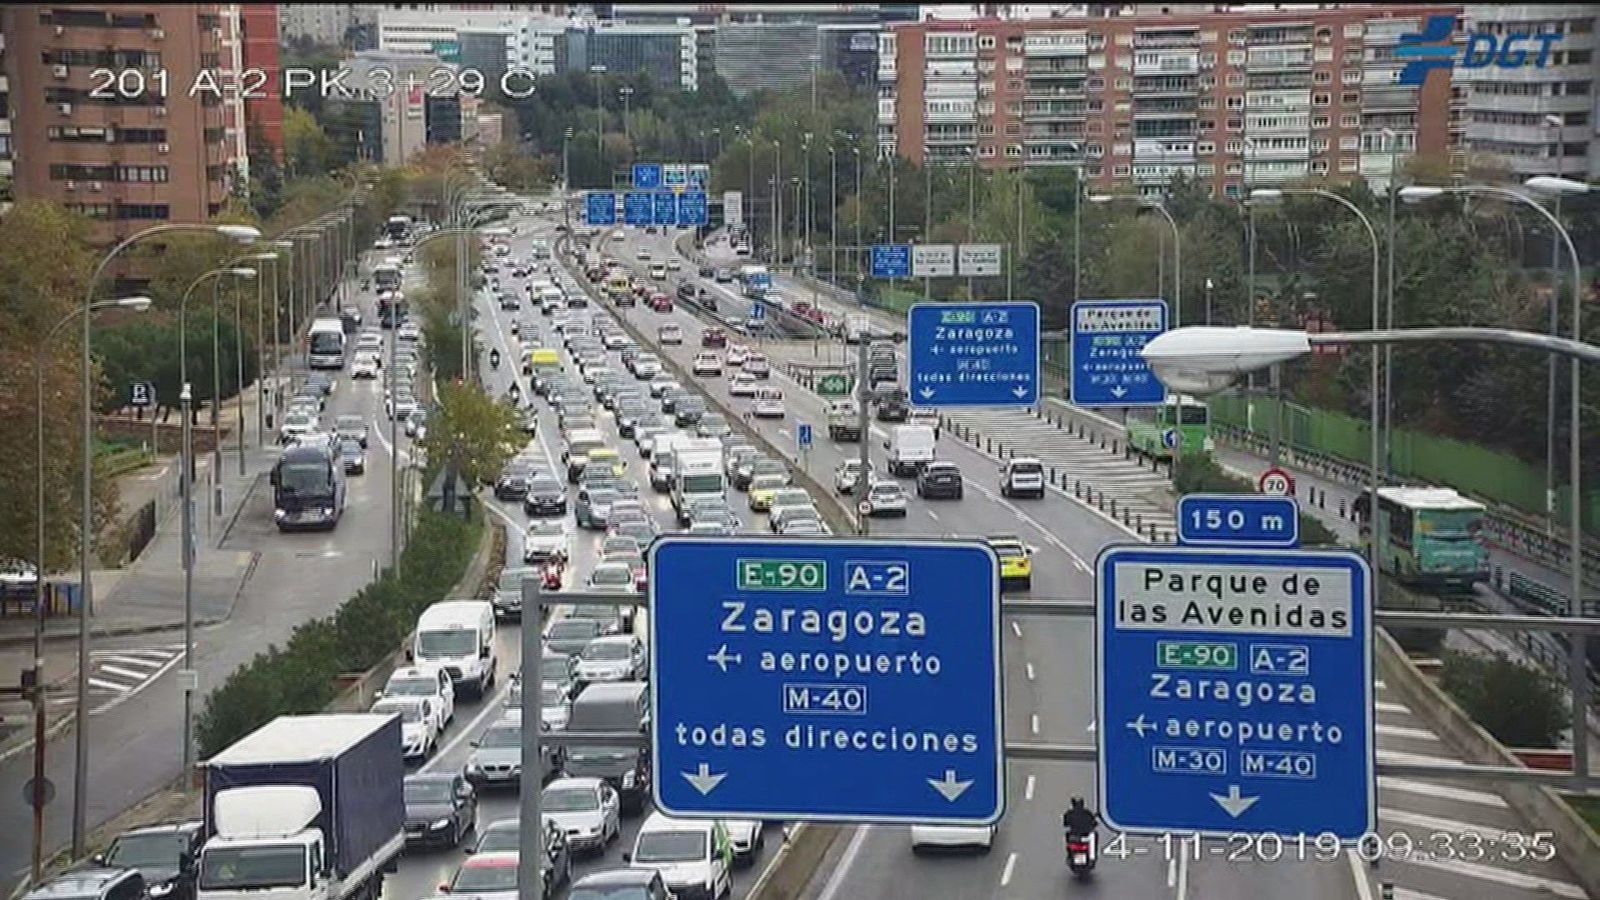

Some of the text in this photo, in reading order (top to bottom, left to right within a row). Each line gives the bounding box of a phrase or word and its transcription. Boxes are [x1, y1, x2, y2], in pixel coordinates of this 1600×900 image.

[935, 326, 1014, 341] Zaragoza
[1267, 479, 1285, 492] 70
[1191, 509, 1283, 531] 150 m
[744, 562, 907, 591] E-90 A-2
[1144, 568, 1321, 599] Parque de
[721, 601, 926, 641] Zaragoza
[1119, 600, 1348, 629] las Avenidas
[760, 650, 941, 677] aeropuerto
[1164, 644, 1308, 672] E-90 A-2
[788, 688, 862, 711] M-40
[1150, 673, 1316, 706] Zaragoza
[675, 722, 978, 752] todas direcciones
[1165, 717, 1343, 745] aeropuerto
[1157, 750, 1311, 775] M-30 M-40
